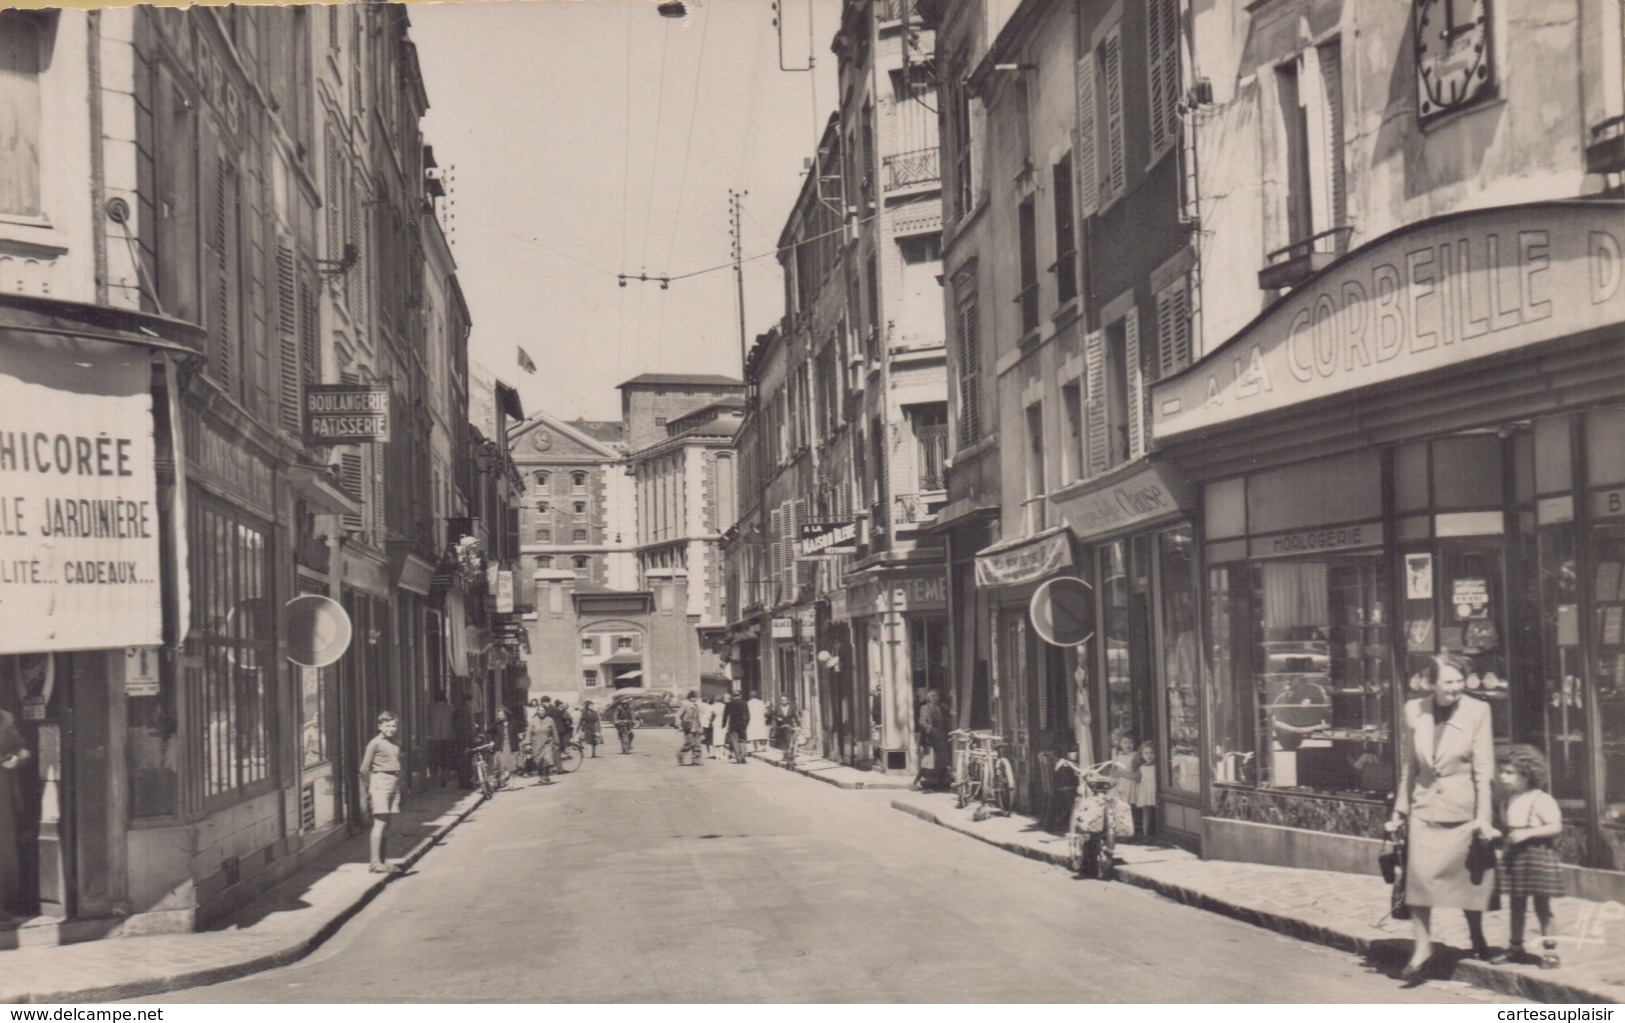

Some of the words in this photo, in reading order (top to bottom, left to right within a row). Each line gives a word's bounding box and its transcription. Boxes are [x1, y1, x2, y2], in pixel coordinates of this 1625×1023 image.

[1203, 373, 1223, 411] A
[1233, 344, 1274, 400] LA
[1286, 229, 1553, 383] CORBEILLE
[308, 394, 389, 411] BOULANGERIE
[312, 418, 385, 436] PATISSERIE
[1114, 484, 1168, 517] Clause
[41, 495, 152, 539] JARDINIÈRE
[1273, 527, 1363, 553] HORLOGERIE
